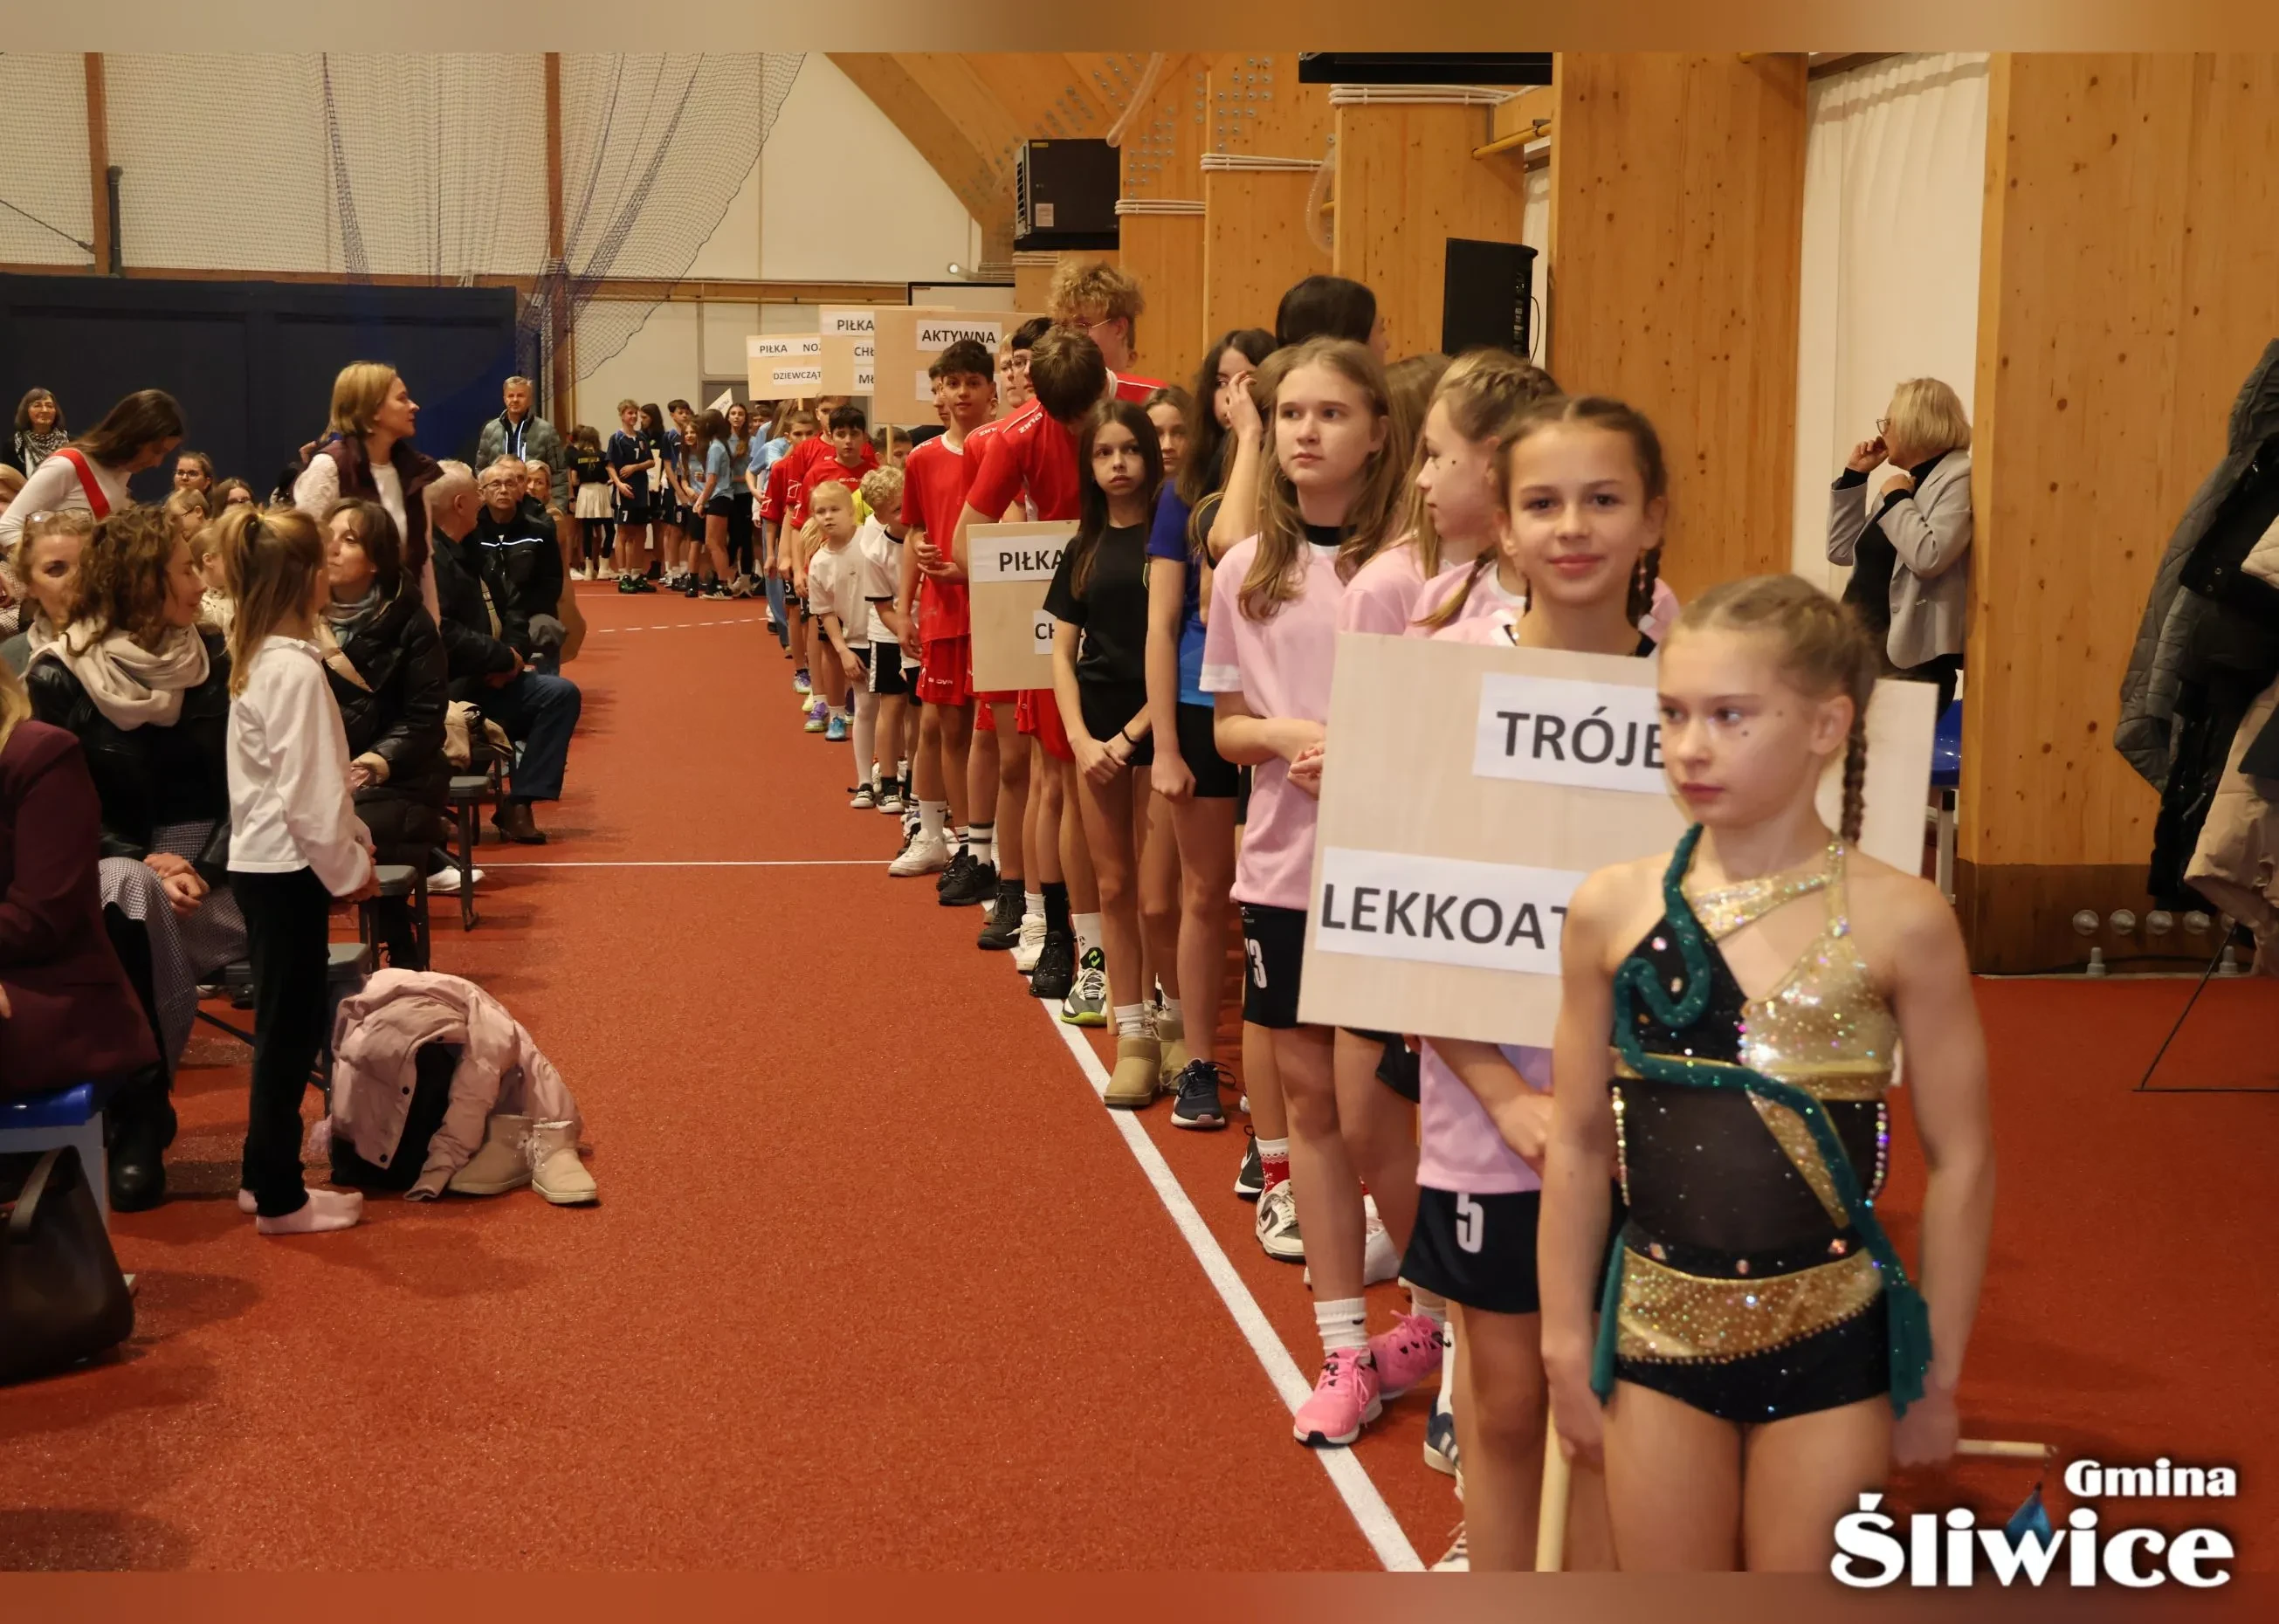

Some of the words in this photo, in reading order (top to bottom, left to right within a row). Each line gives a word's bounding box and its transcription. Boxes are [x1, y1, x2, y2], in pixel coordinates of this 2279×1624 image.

[837, 320, 874, 331] PIŁKA
[922, 329, 995, 343] AKTYWNA
[760, 344, 788, 354] PIŁKA
[802, 343, 821, 352] NO
[773, 371, 821, 380] DZIEWCZĄT
[999, 549, 1064, 572] PIŁKA
[1496, 705, 1665, 769] TRÓJE
[1456, 1192, 1484, 1254] 5
